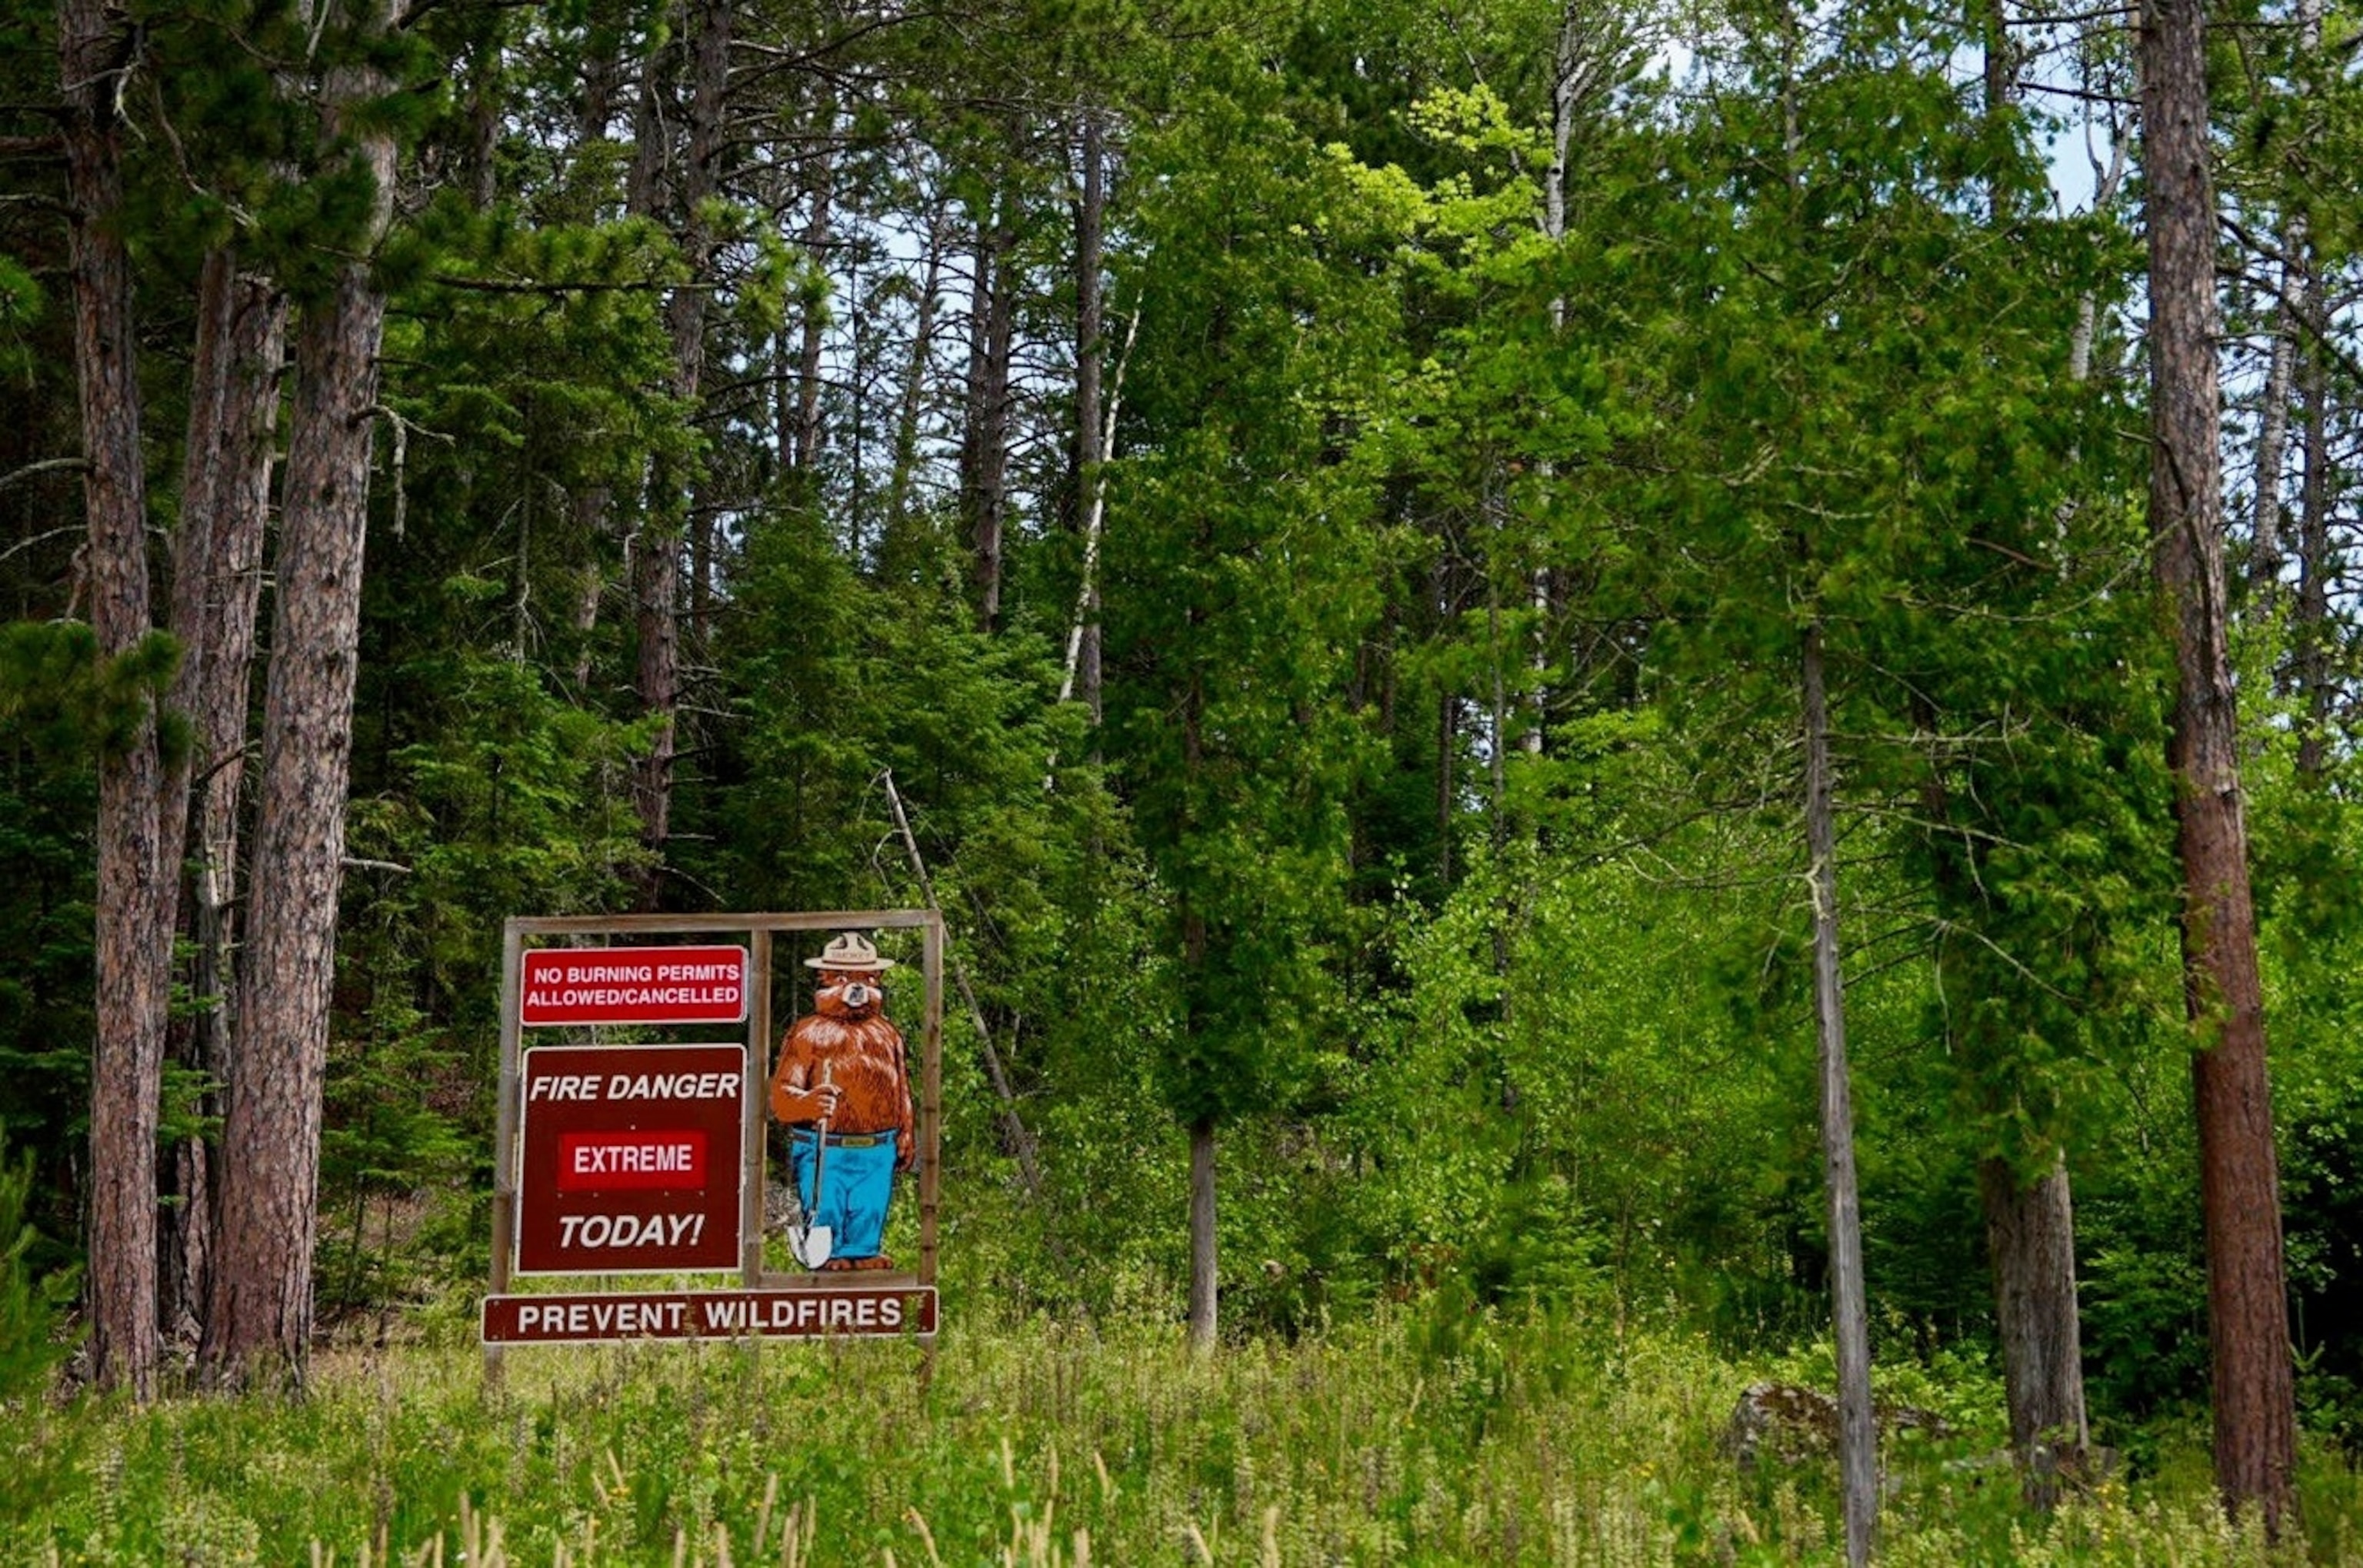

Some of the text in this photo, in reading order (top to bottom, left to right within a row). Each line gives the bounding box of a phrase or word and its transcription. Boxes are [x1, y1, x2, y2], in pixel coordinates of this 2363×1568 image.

[534, 964, 740, 984] NO BURNING PERMITS
[527, 987, 738, 1007] ALLOWED/CANCELLED
[529, 1073, 739, 1101] FIRE DANGER
[574, 1144, 692, 1173] EXTREME
[558, 1214, 705, 1248] TODAY!
[518, 1297, 902, 1333] PREVENT WILDFIRES
